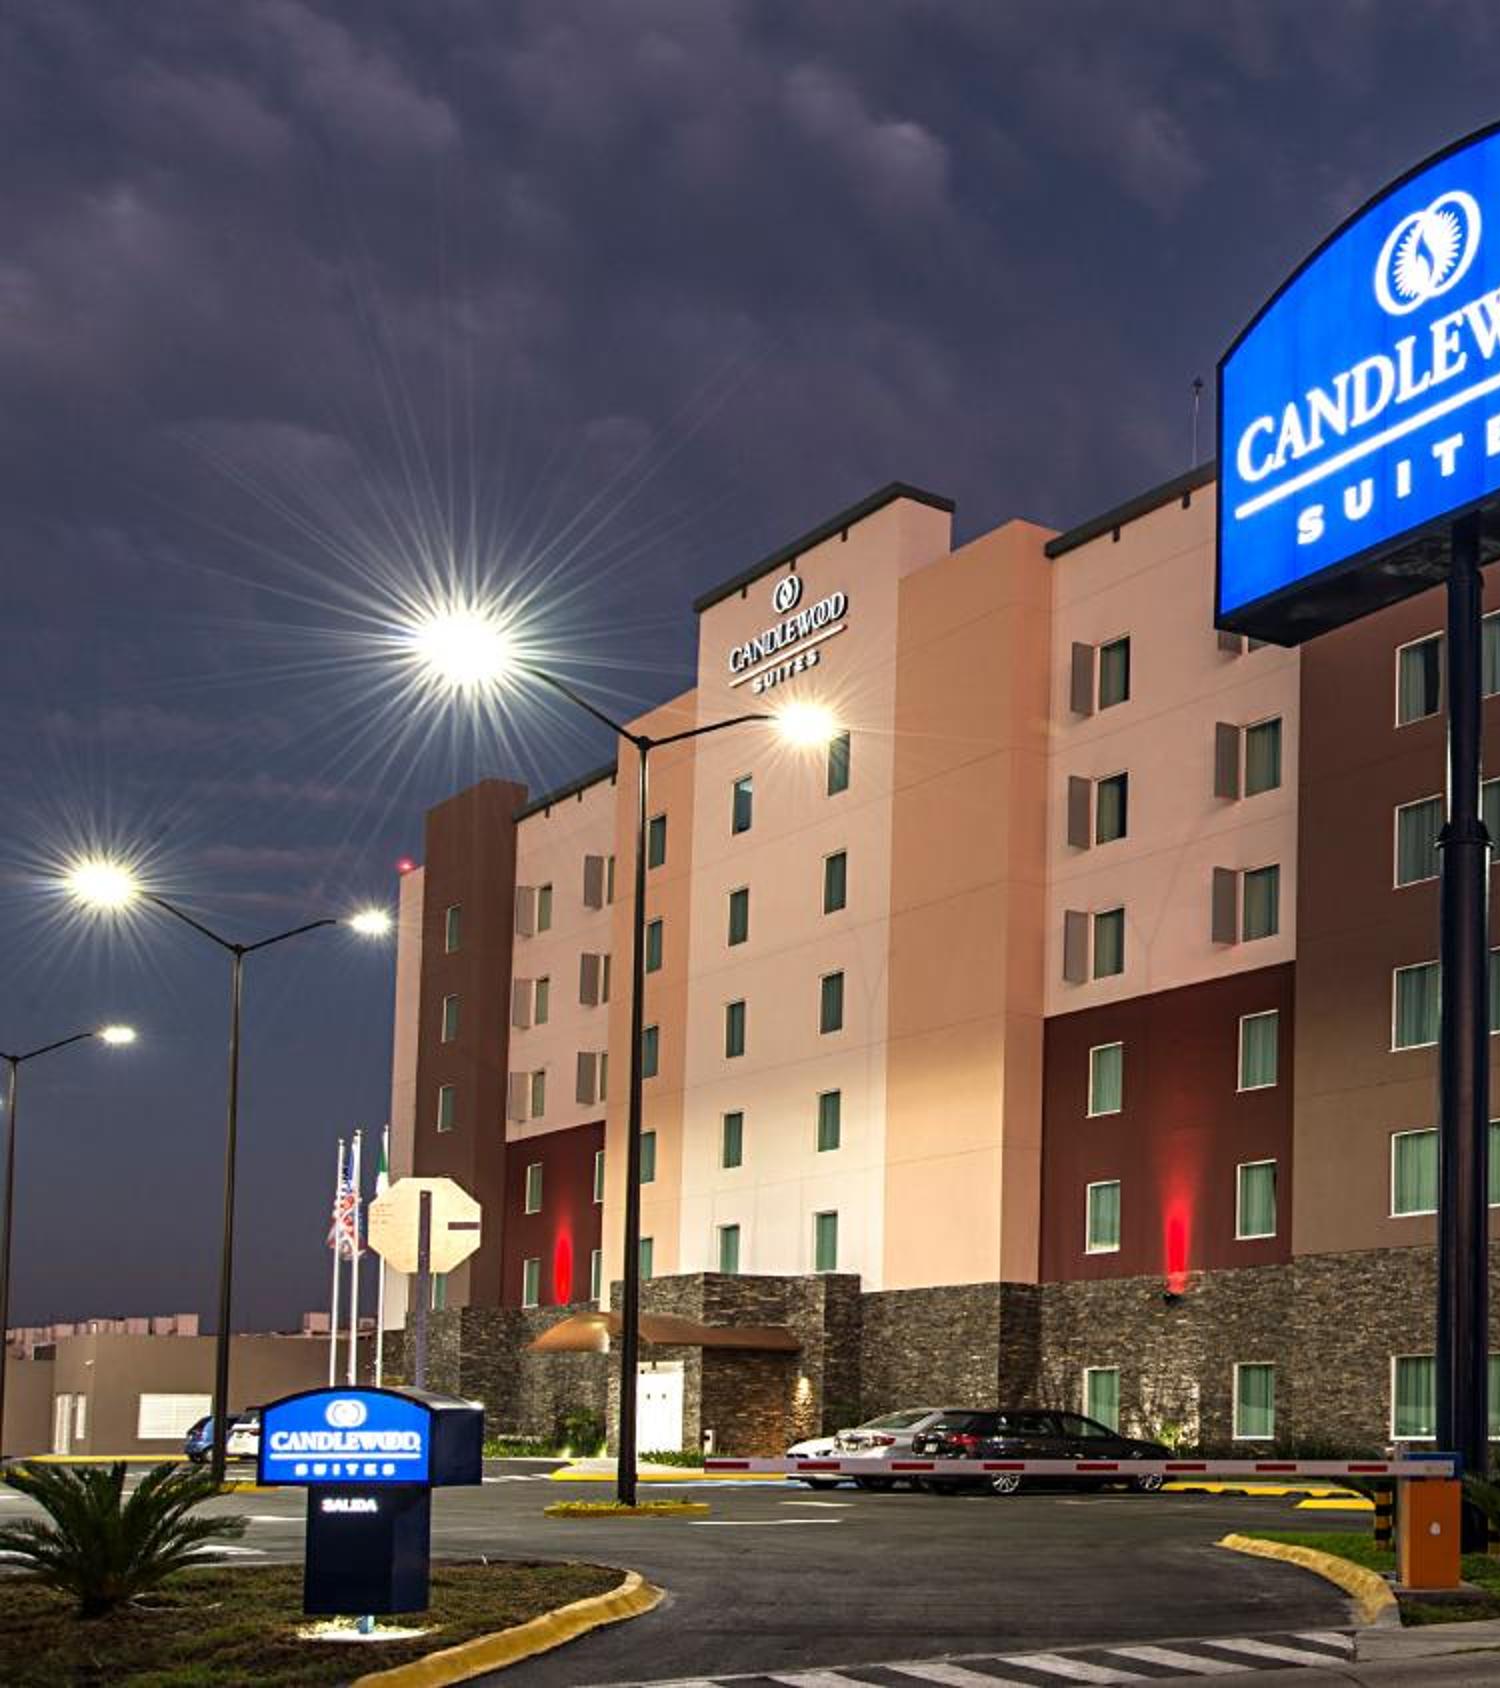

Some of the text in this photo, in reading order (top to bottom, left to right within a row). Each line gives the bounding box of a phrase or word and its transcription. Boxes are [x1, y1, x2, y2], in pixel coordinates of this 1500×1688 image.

[729, 591, 847, 673] CANDLEWOOD
[751, 650, 819, 693] SUITES
[295, 1463, 395, 1476] SUITES
[321, 1498, 378, 1512] SALIDA
